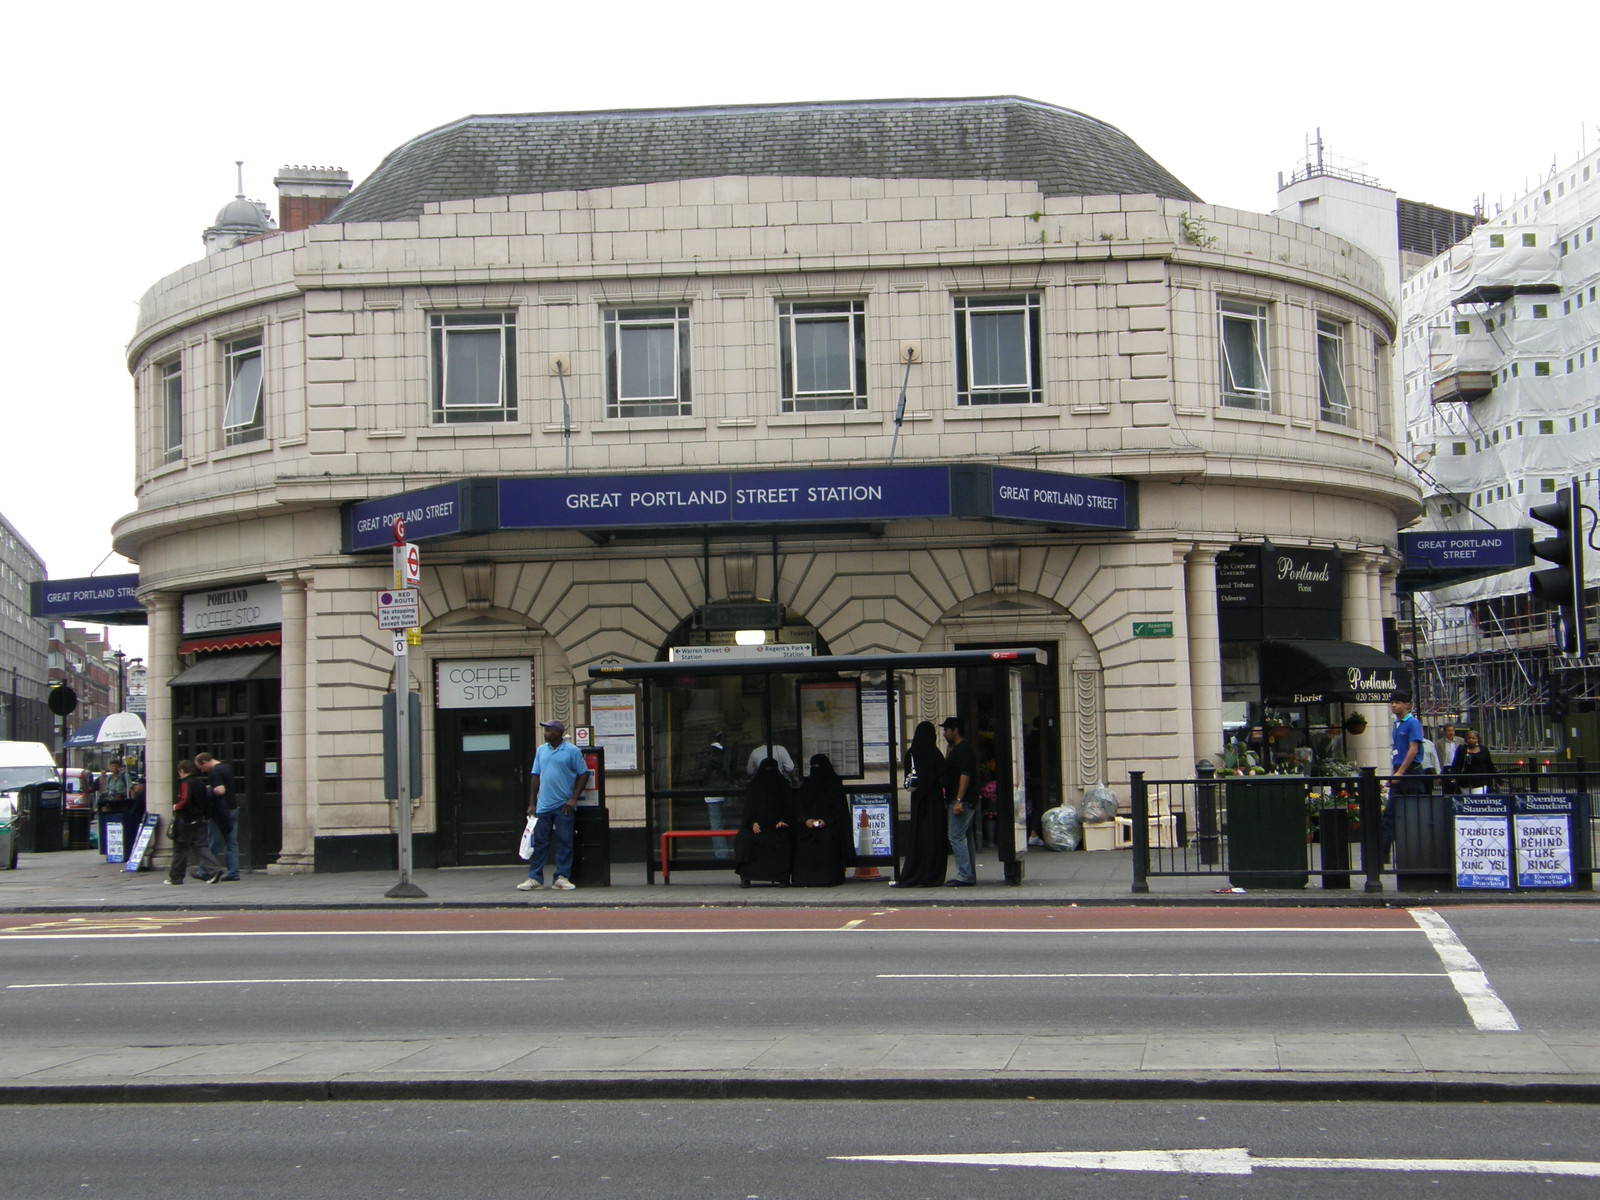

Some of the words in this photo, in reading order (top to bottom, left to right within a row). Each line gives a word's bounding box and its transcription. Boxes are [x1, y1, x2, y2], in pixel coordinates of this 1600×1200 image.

[566, 493, 622, 509] GREAT
[630, 490, 727, 507] PORTLAND
[736, 488, 799, 504] STREET
[807, 485, 882, 502] STATION
[999, 485, 1030, 501] GREAT
[1033, 489, 1084, 506] PORTLAND
[1087, 495, 1118, 510] STREET
[357, 516, 380, 533] GREAT
[425, 501, 454, 519] STREET
[397, 520, 405, 537] G
[1417, 540, 1447, 550] GREAT
[1450, 539, 1502, 549] PORTLAND
[1443, 550, 1477, 559] STREET
[1277, 556, 1329, 581] Portlands
[1297, 584, 1312, 592] Florist
[47, 592, 71, 602] GREAT
[73, 588, 115, 600] PORTLAND
[207, 589, 248, 607] PORTLAND
[195, 610, 232, 629] COFFEE
[236, 606, 260, 625] STOP
[449, 667, 521, 684] COFFEE
[1347, 666, 1397, 690] Portlands
[463, 685, 508, 701] STOP
[1294, 693, 1323, 703] Florist
[1356, 692, 1368, 701] 020
[1368, 692, 1381, 701] 7580
[1381, 692, 1392, 701] 205
[1463, 797, 1502, 805] Evening
[1526, 795, 1567, 803] Evening
[1526, 801, 1572, 810] Standard
[1460, 828, 1505, 837] TRIBUTES
[1522, 826, 1562, 836] BANKER
[1469, 838, 1483, 847] TO
[1521, 838, 1563, 848] BEHIND
[1460, 848, 1506, 858] FASHION
[1526, 849, 1555, 858] TUBE
[1461, 861, 1484, 870] KING
[1488, 860, 1507, 871] YSL
[1527, 860, 1560, 870] BINGE
